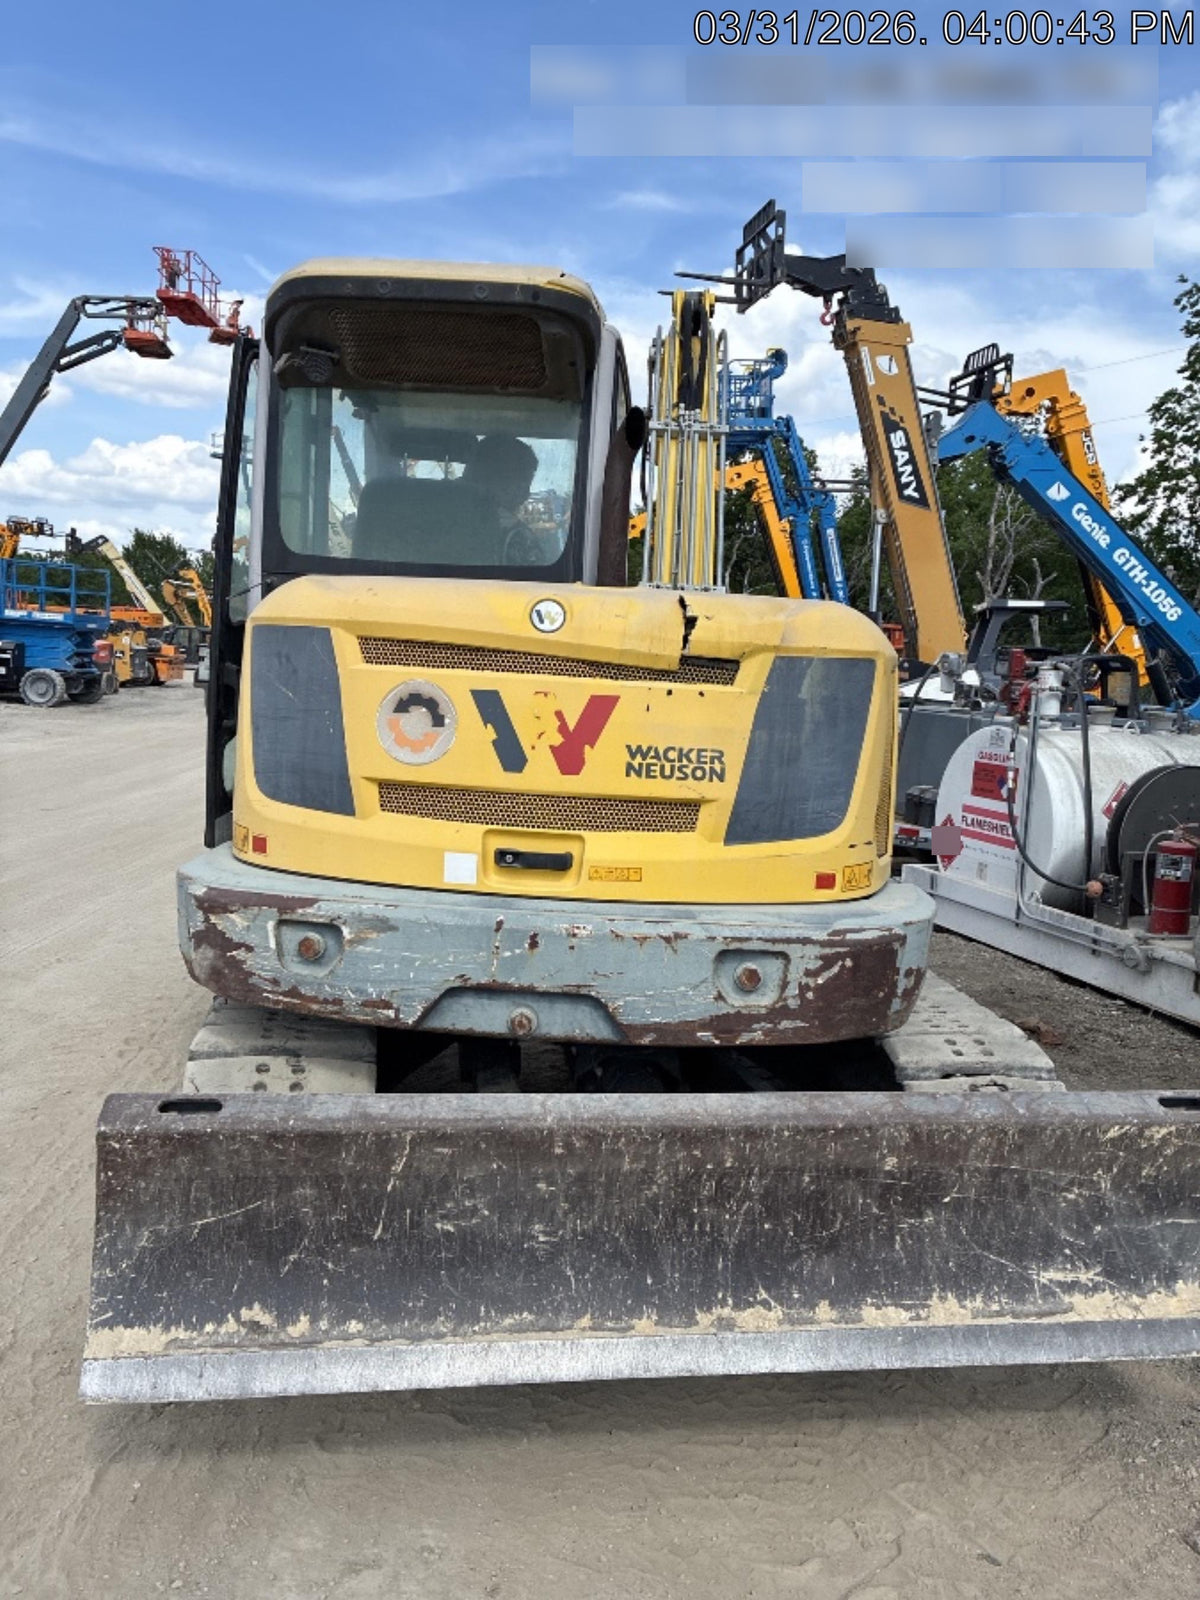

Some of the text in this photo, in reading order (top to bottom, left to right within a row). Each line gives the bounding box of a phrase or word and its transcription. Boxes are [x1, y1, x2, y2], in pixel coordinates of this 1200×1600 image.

[890, 429, 920, 498] SANY
[1071, 502, 1183, 621] Genie GTH-1056
[625, 744, 726, 767] WACKER
[624, 762, 727, 784] NEUSON
[961, 815, 1014, 838] FLAMESHIEL
